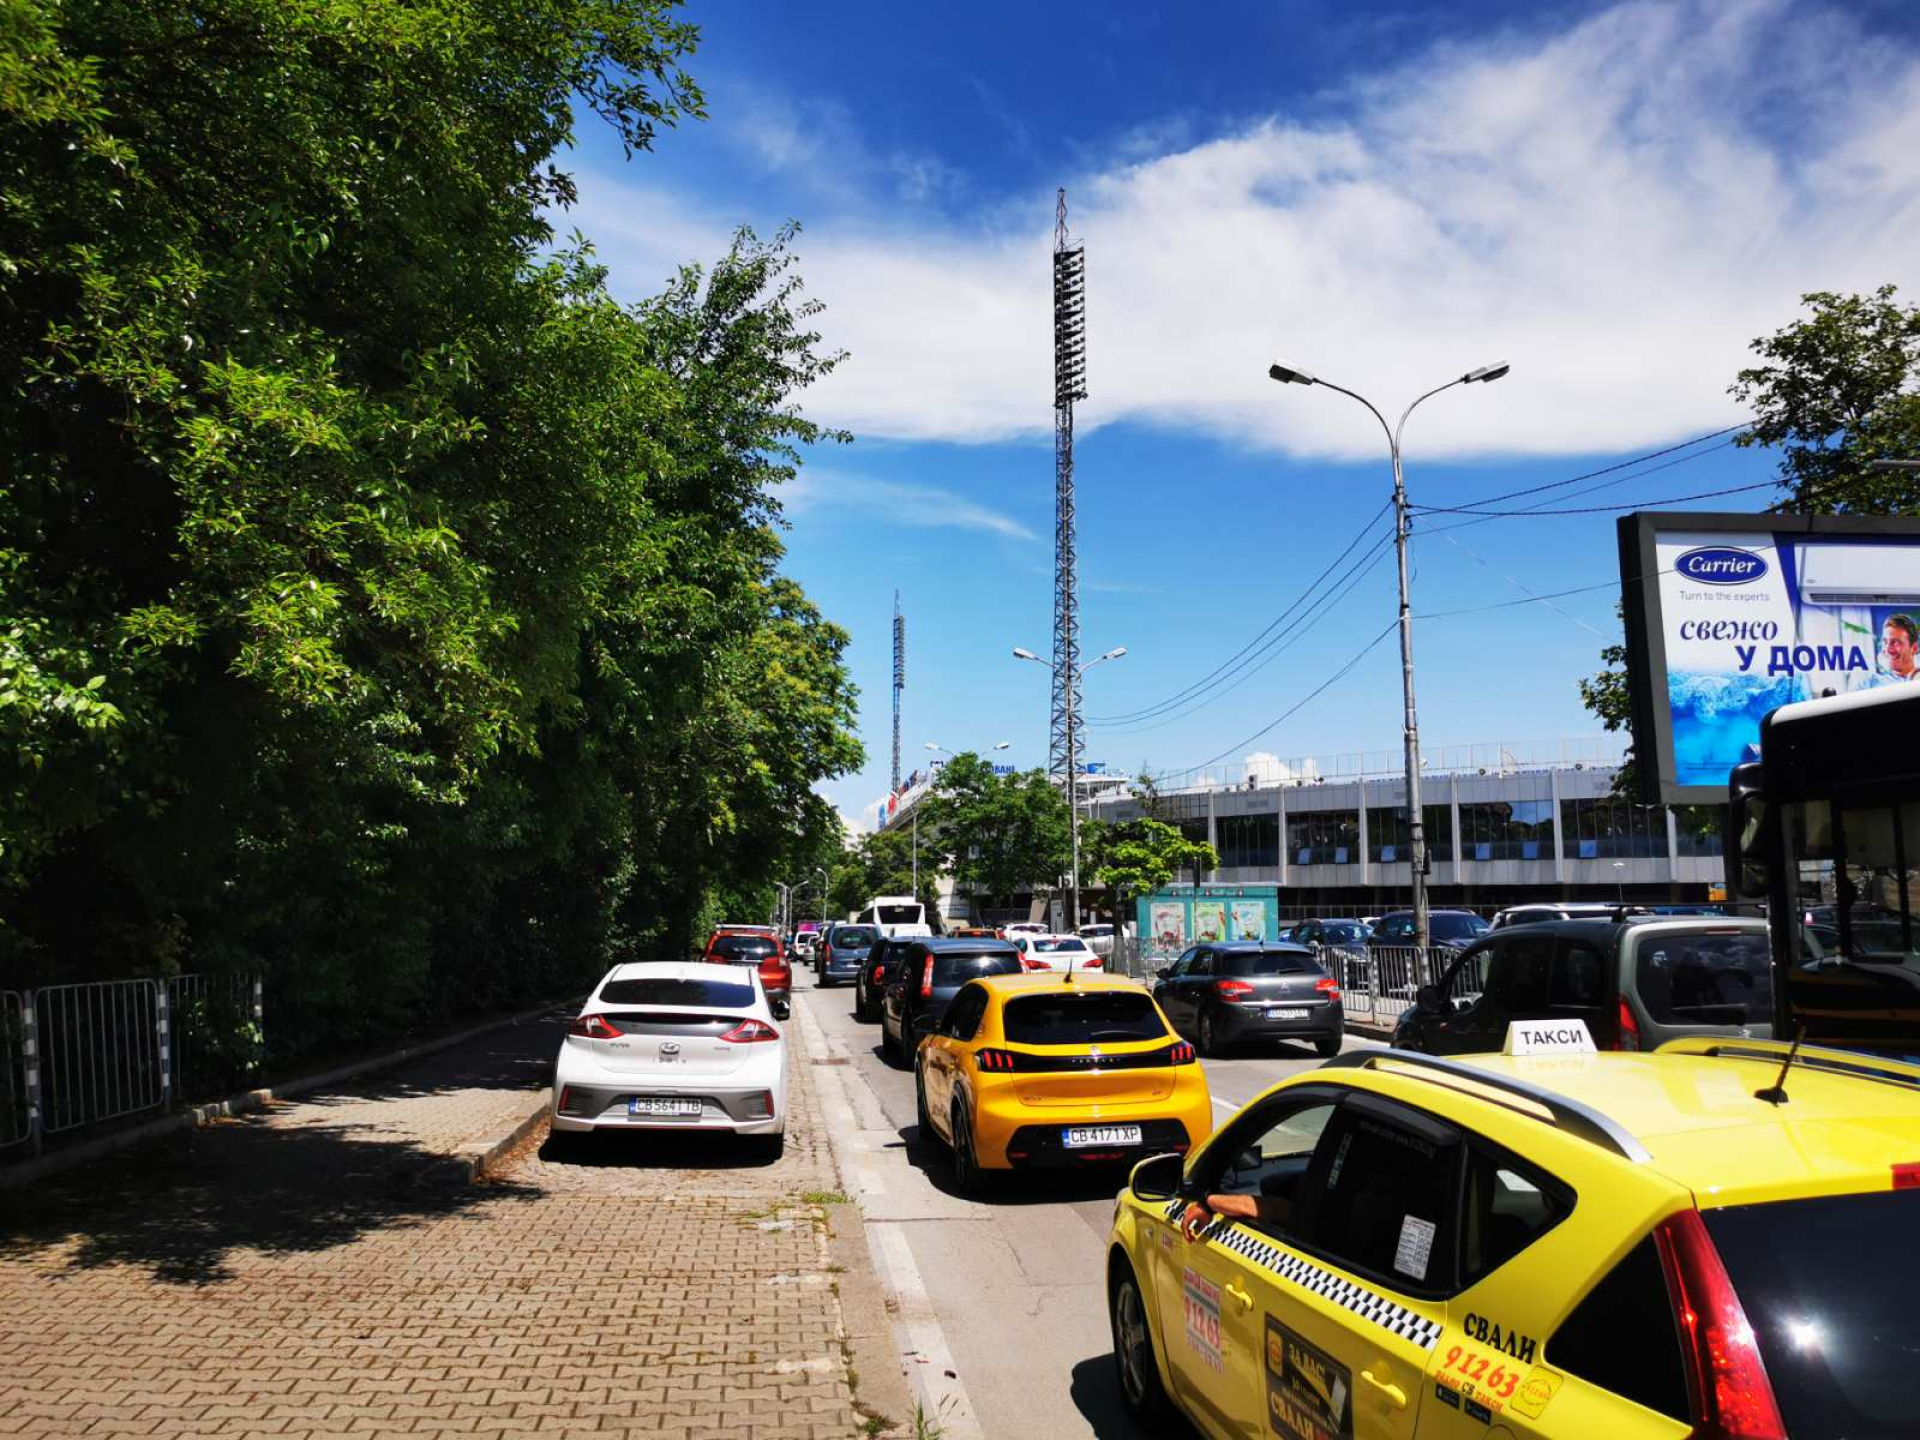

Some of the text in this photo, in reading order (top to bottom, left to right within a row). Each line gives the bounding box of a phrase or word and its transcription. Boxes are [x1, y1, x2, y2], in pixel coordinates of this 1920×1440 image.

[1688, 556, 1756, 573] Carrier
[1680, 590, 1770, 602] Turn to the experts
[1679, 620, 1778, 641] свежо
[1734, 645, 1869, 677] У ДОМА
[1520, 1029, 1583, 1045] ТАКСИ
[1443, 1345, 1520, 1398] 91263
